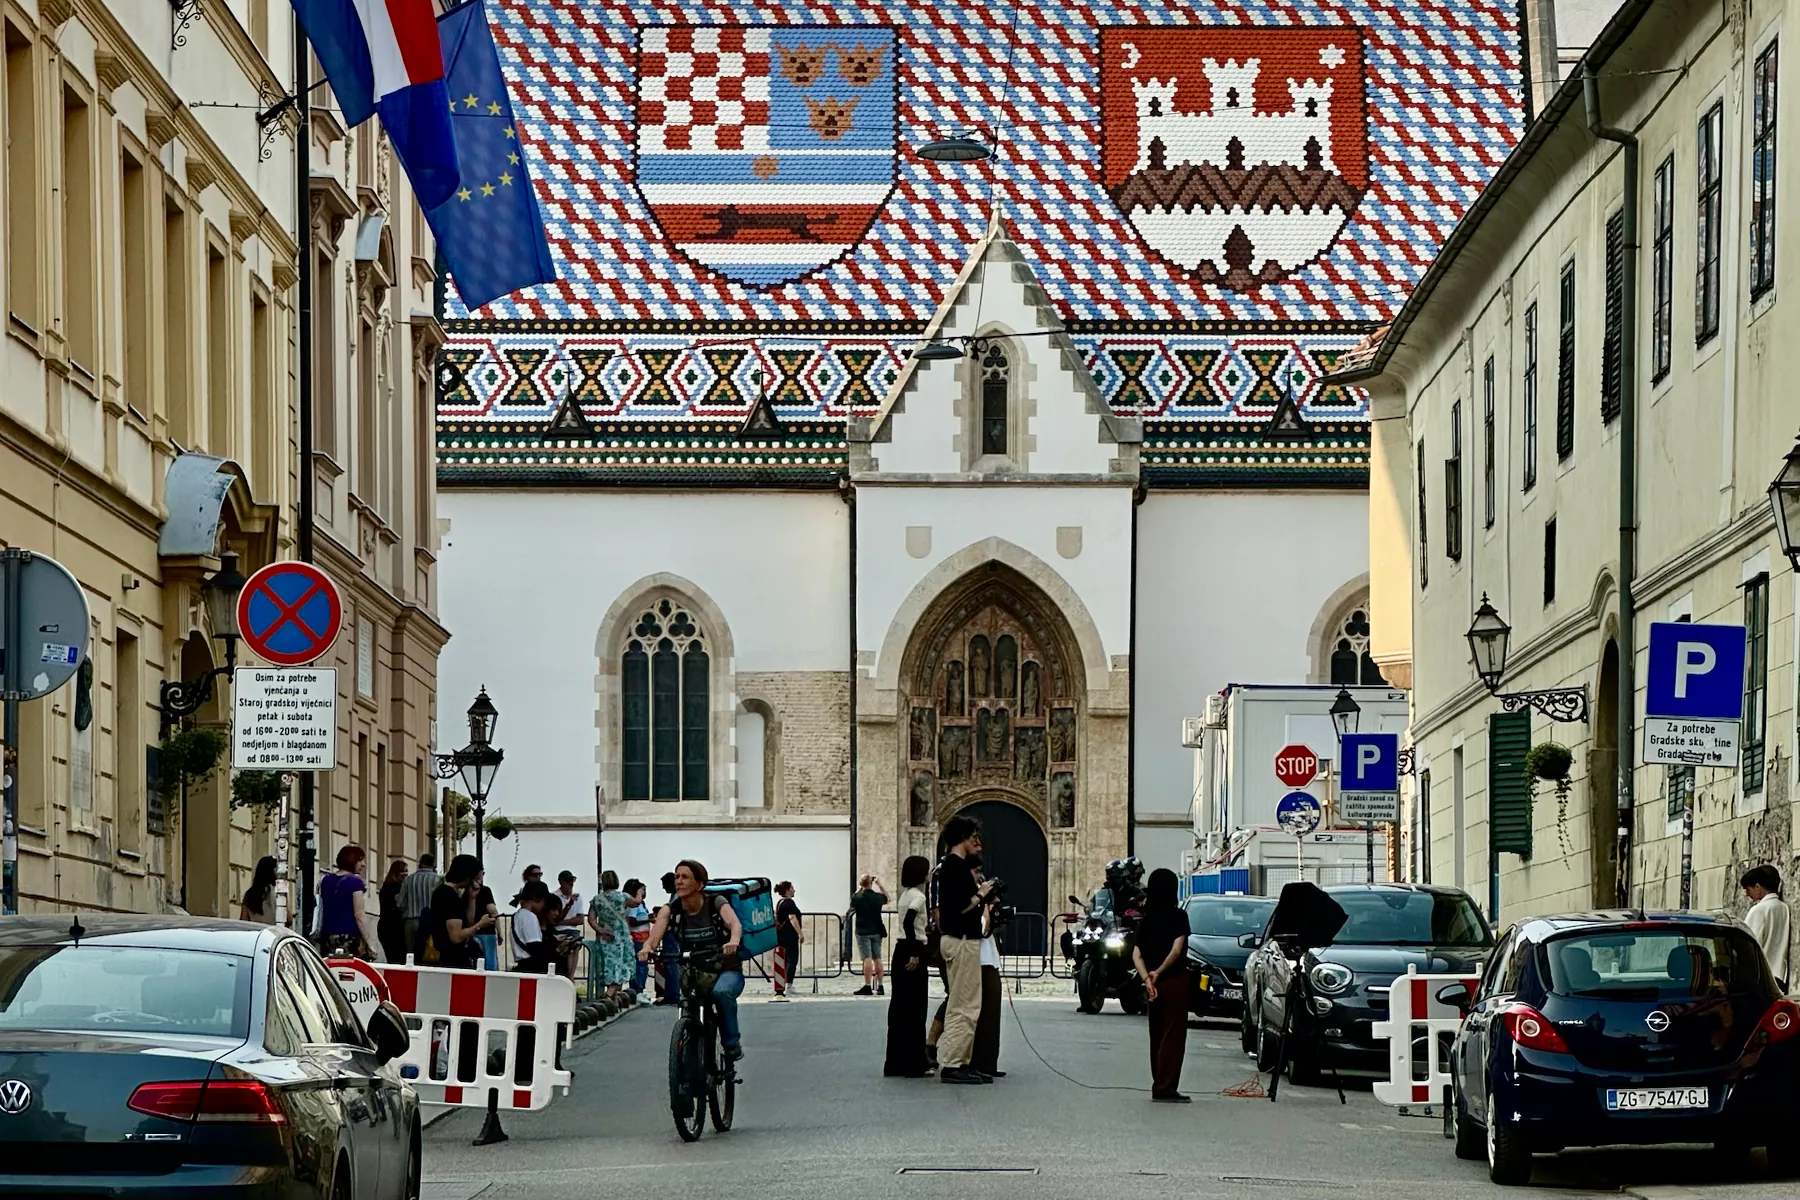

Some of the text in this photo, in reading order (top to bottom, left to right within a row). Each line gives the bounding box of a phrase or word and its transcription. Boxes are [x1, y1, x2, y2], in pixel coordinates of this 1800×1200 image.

[1674, 641, 1717, 699] P
[255, 673, 274, 682] Osim
[288, 674, 317, 683] potrebe
[239, 698, 263, 708] Staroj
[265, 699, 298, 709] gradskoj
[257, 712, 278, 722] petak
[287, 713, 313, 721] subota
[242, 727, 251, 735] od
[301, 728, 317, 736] sati
[319, 728, 327, 736] te
[1667, 722, 1716, 734] Za potrebe
[242, 740, 279, 750] nedjeljom
[286, 740, 327, 751] blagdanom
[1650, 734, 1732, 748] Gradske skutine
[247, 754, 256, 763] od
[306, 755, 322, 764] sati
[1657, 748, 1683, 759] Grada
[1277, 757, 1315, 775] STOP
[1357, 744, 1381, 779] P
[1618, 1091, 1638, 1108] ZG
